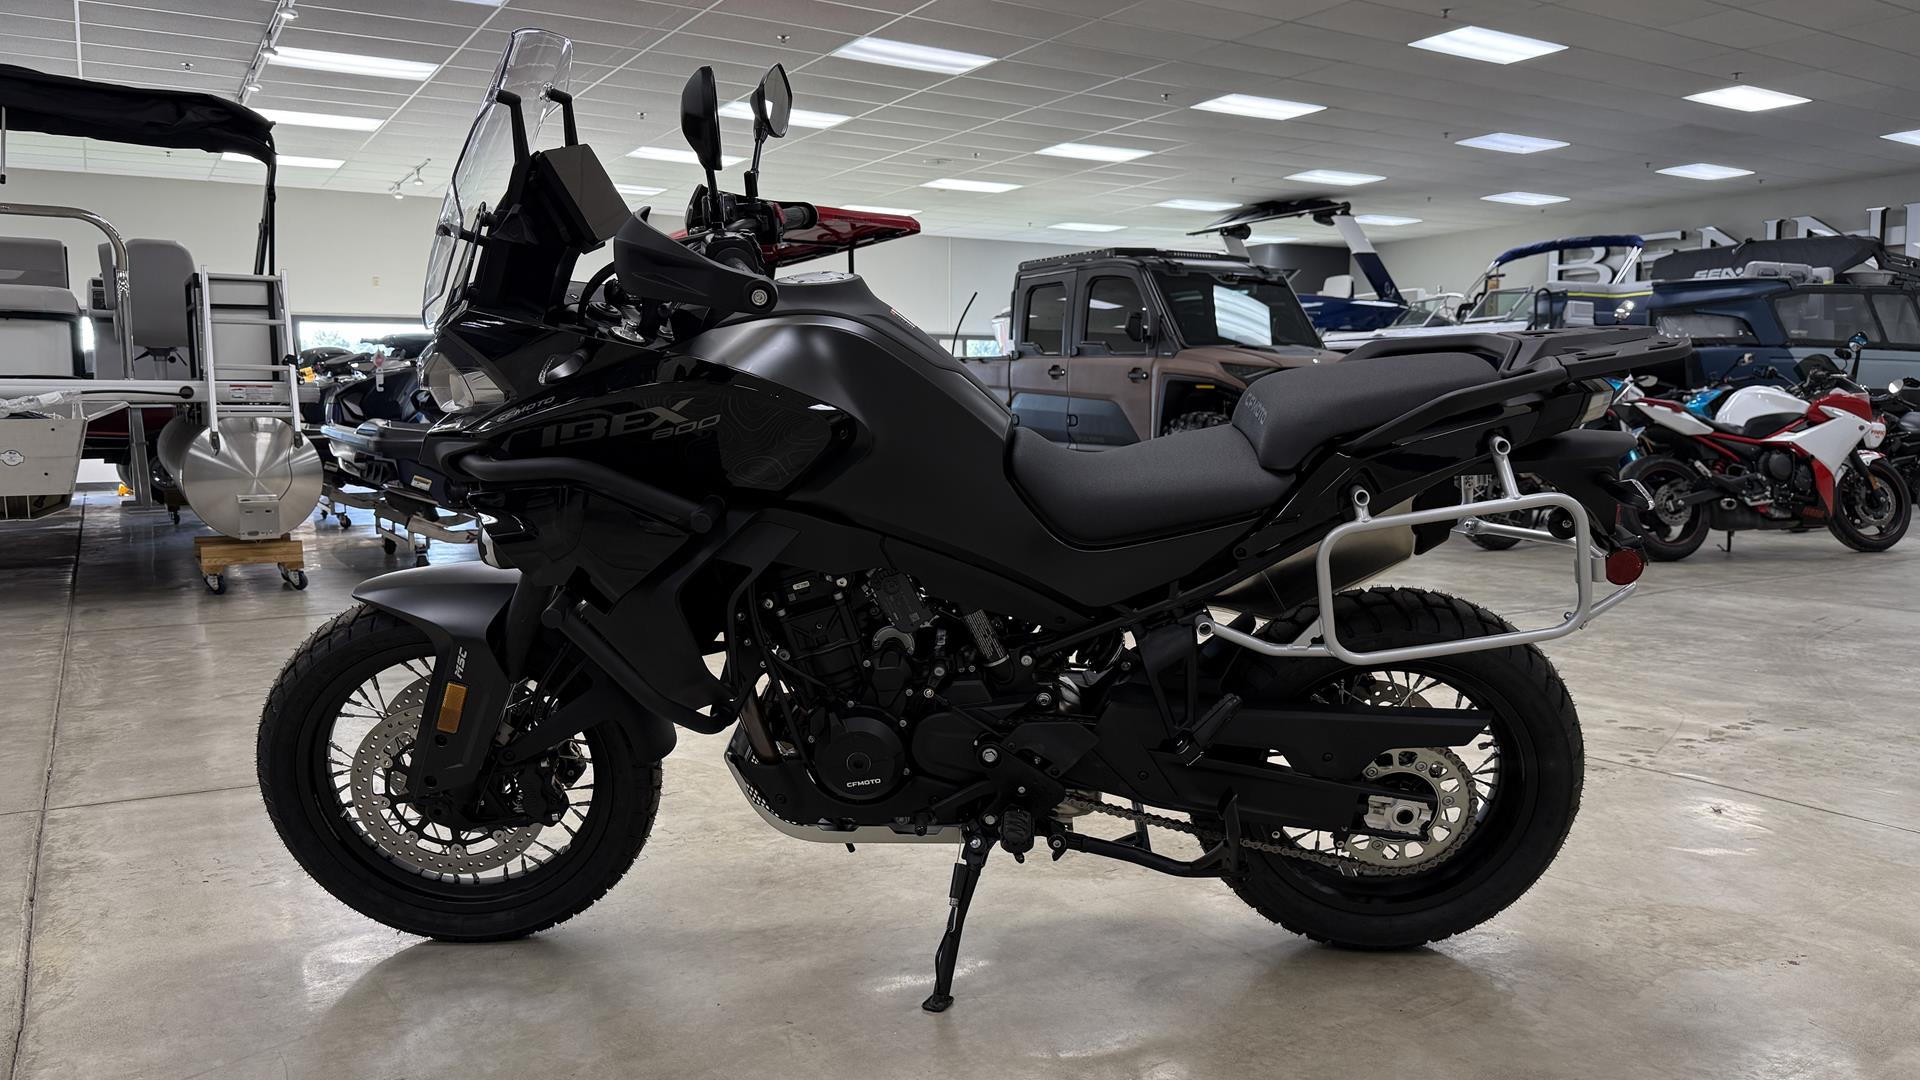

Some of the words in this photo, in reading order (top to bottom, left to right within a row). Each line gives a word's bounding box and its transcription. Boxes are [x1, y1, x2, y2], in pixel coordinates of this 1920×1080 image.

[541, 397, 695, 448] IBEX
[651, 414, 721, 441] 800
[846, 778, 881, 788] CFMOTO
